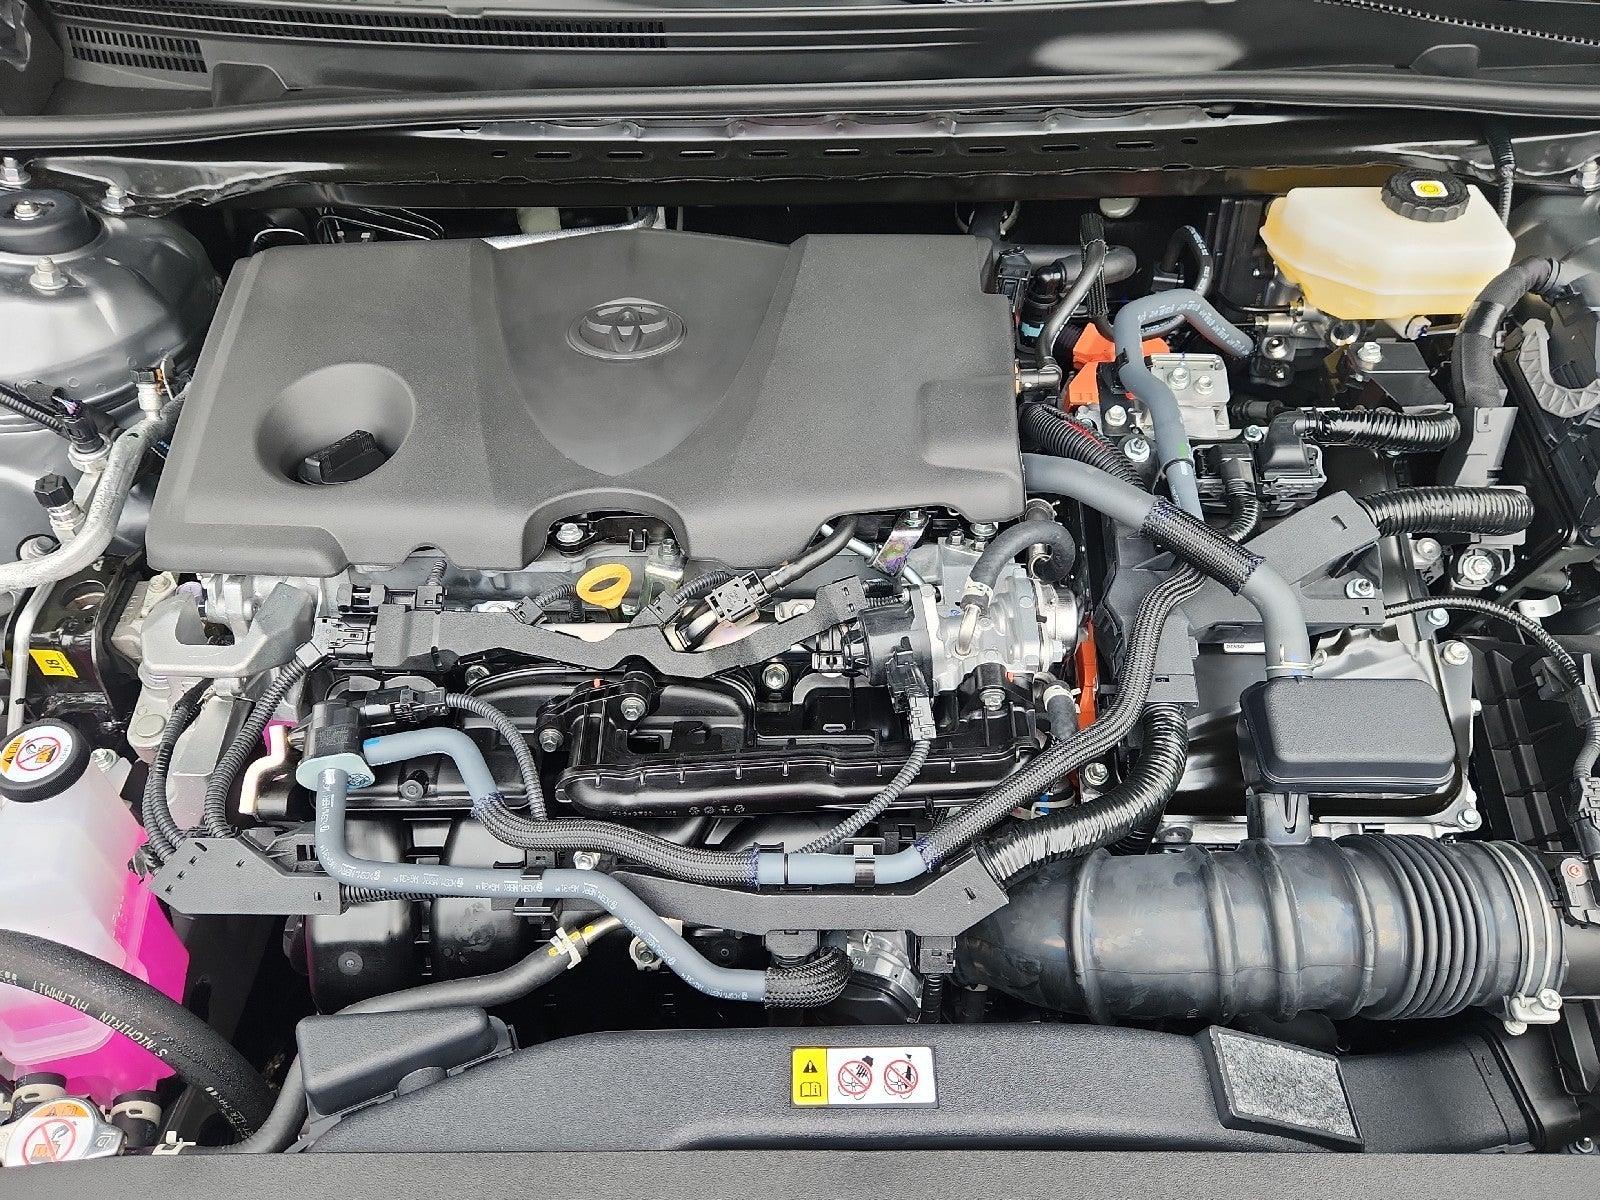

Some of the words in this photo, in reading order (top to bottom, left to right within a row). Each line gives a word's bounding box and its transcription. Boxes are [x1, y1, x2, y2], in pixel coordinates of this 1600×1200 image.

[45, 659, 64, 671] J8
[32, 980, 90, 1012] HYLAMMIT
[98, 1011, 158, 1050] NICHIRIN
